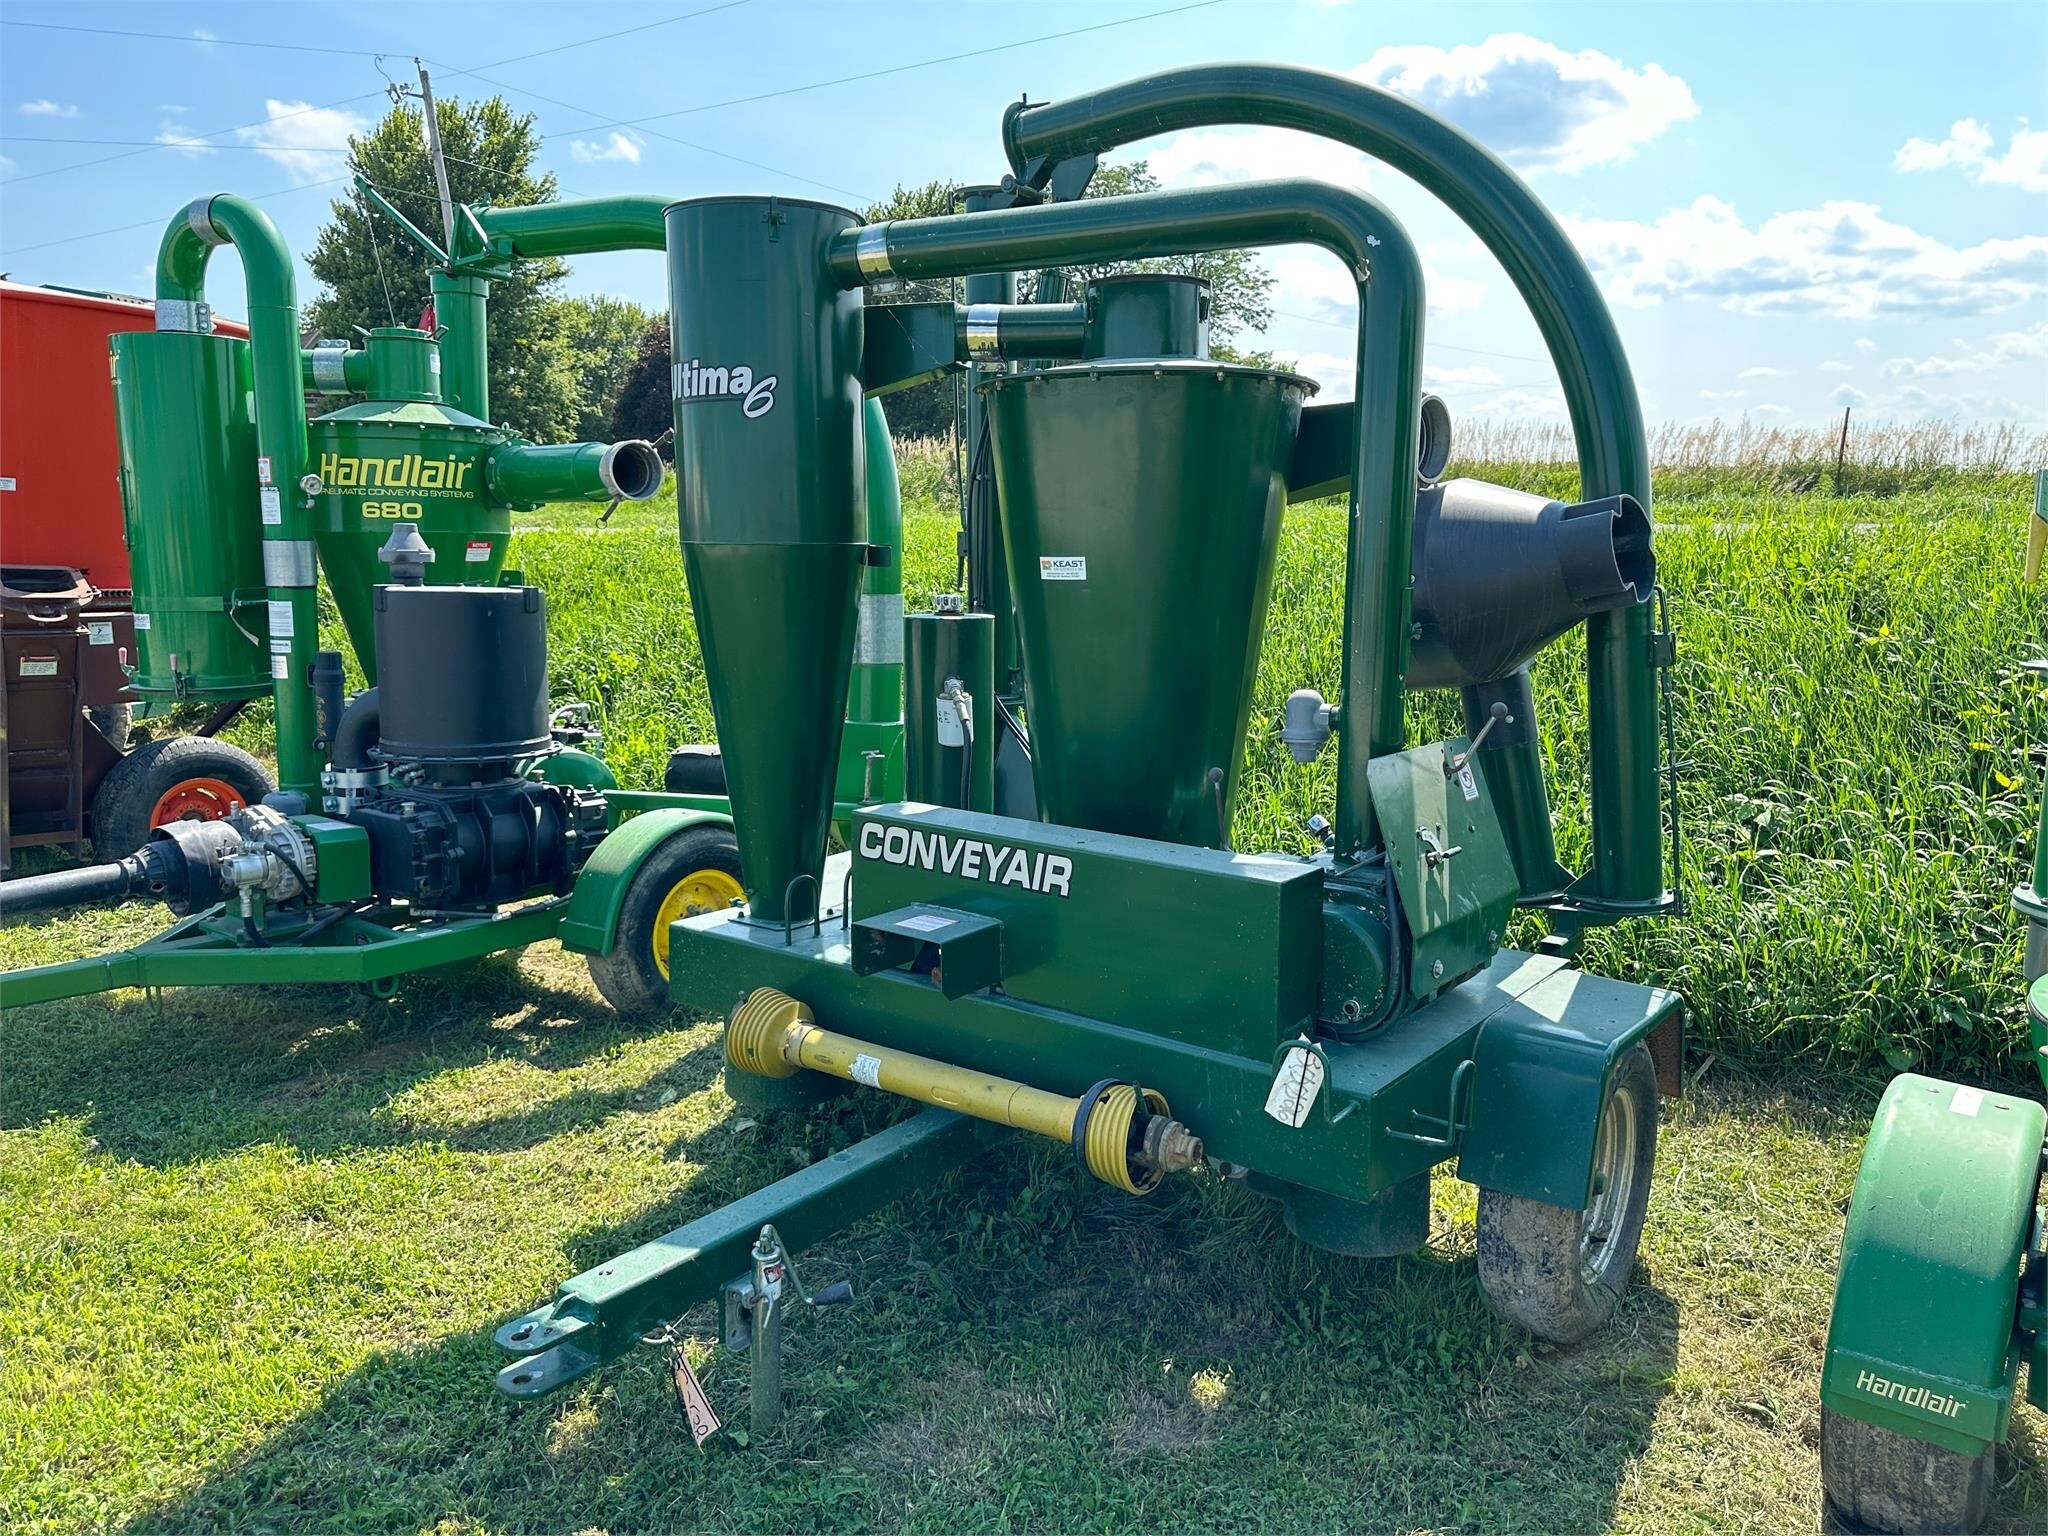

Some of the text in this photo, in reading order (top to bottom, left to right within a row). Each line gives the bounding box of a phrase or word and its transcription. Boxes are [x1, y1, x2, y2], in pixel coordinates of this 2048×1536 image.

[743, 377, 777, 418] 6
[321, 453, 472, 489] Handlair
[362, 502, 423, 519] 680
[368, 489, 428, 497] CONVEYING
[430, 490, 474, 498] SYSTEMS
[860, 822, 1073, 897] CONVEYAIR
[1856, 1370, 1966, 1418] Handlair
